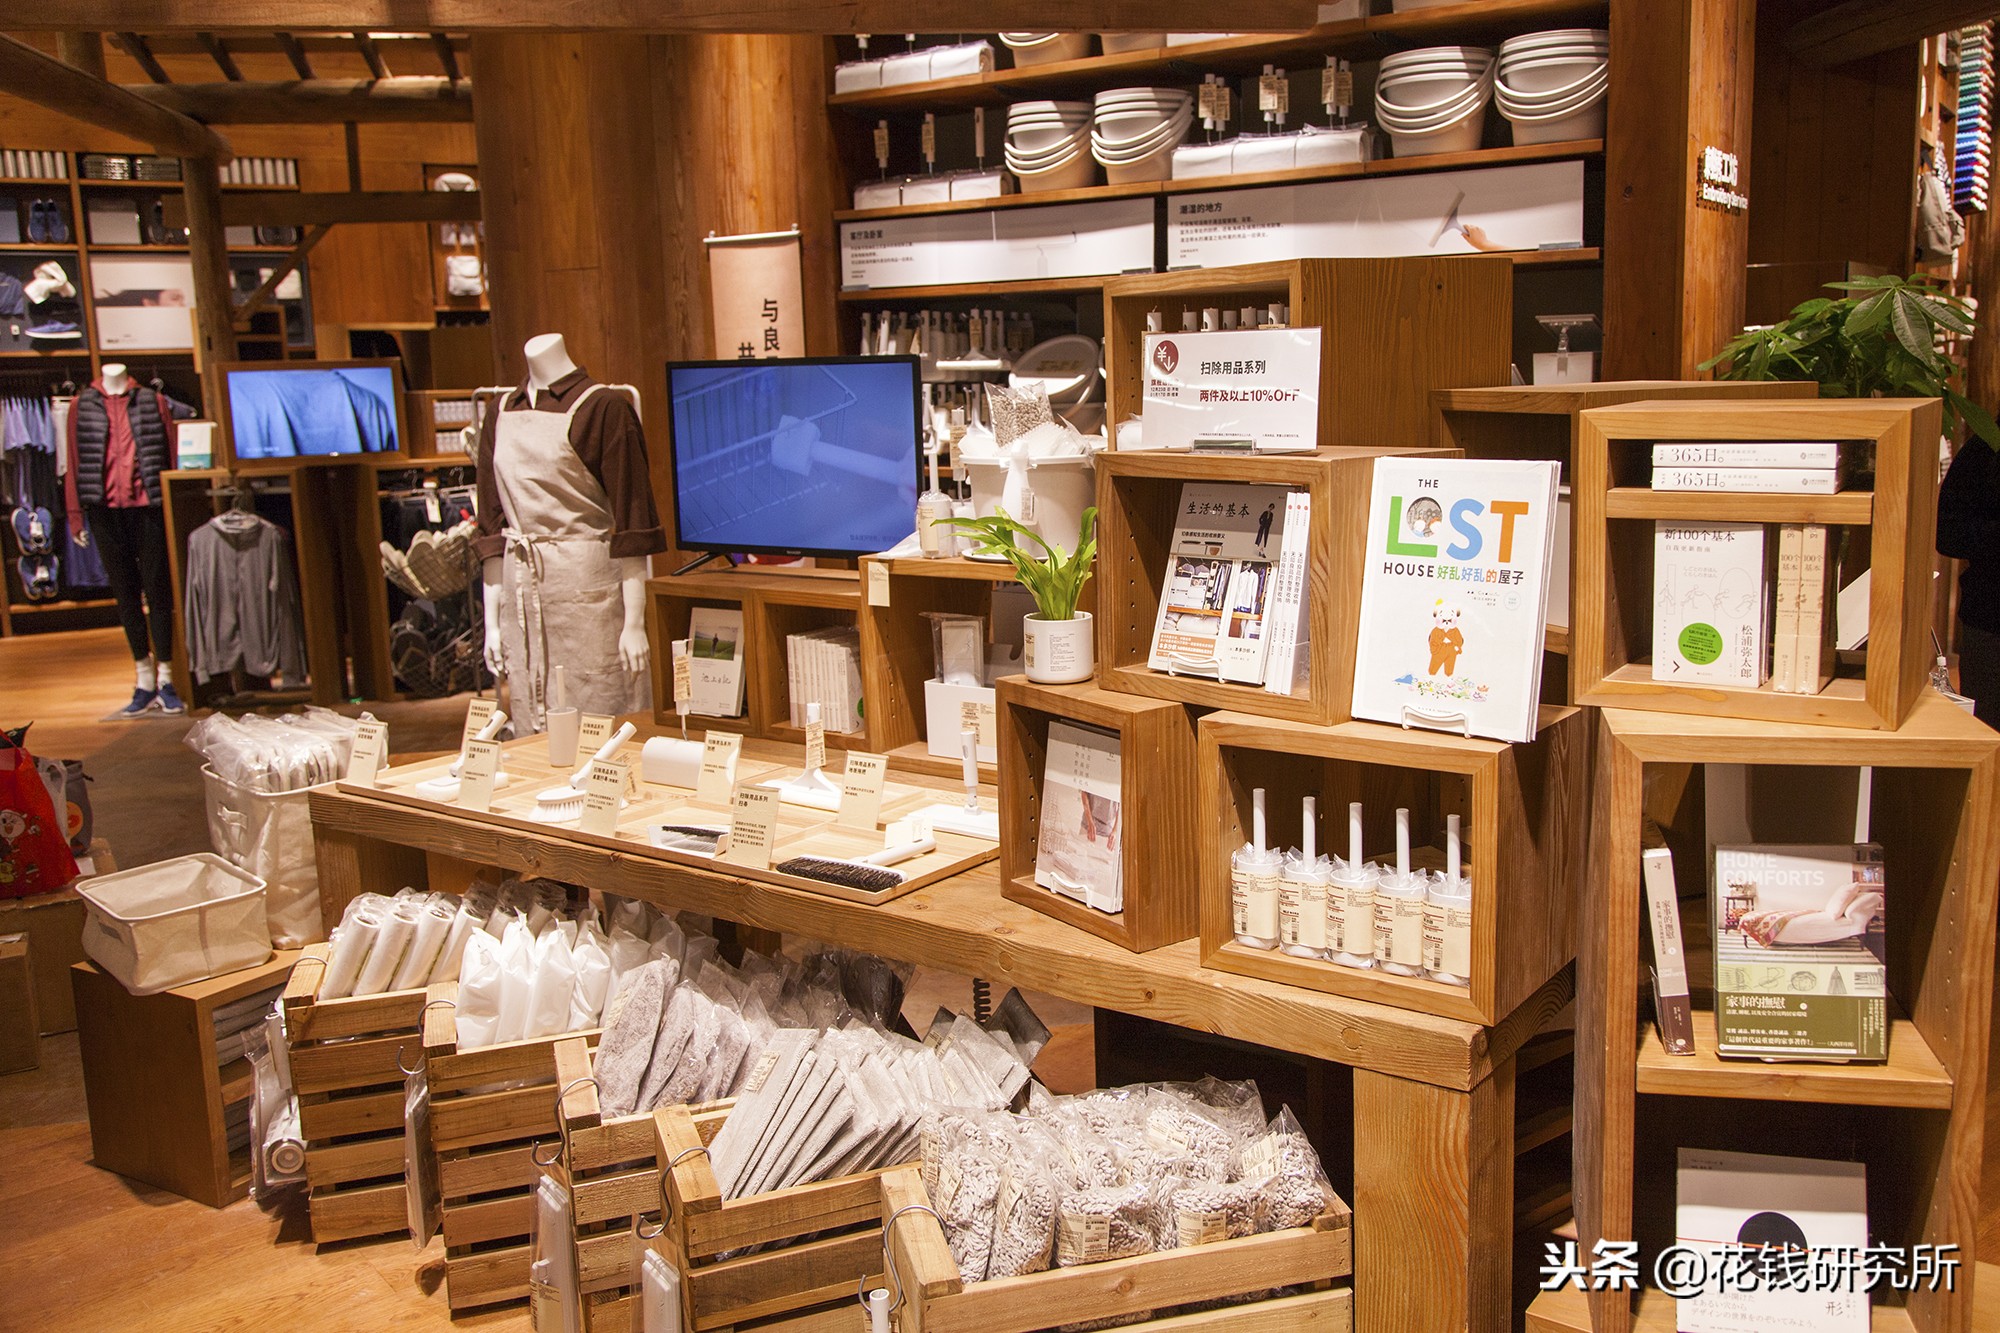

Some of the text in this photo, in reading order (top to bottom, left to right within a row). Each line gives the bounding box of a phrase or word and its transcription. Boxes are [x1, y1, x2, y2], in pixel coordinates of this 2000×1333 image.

[1179, 202, 1222, 214] 潮湿的地方
[761, 298, 780, 359] 与良
[1200, 360, 1266, 375] 扫除用品系列
[1199, 388, 1300, 402] 两件及以上10%OFF
[1418, 478, 1439, 488] THE
[1186, 501, 1250, 518] 生活的基本
[1386, 496, 1529, 563] LOST
[1664, 528, 1736, 542] 新100个基本
[1383, 562, 1524, 585] HOUSE 好乱好乱的屋子
[1740, 624, 1753, 678] 松浦弥太郎
[1722, 852, 1778, 868] HOME
[1722, 870, 1825, 886] COMFORTS
[1725, 995, 1786, 1009] 家事的撫慰
[1825, 1301, 1844, 1317] 形
